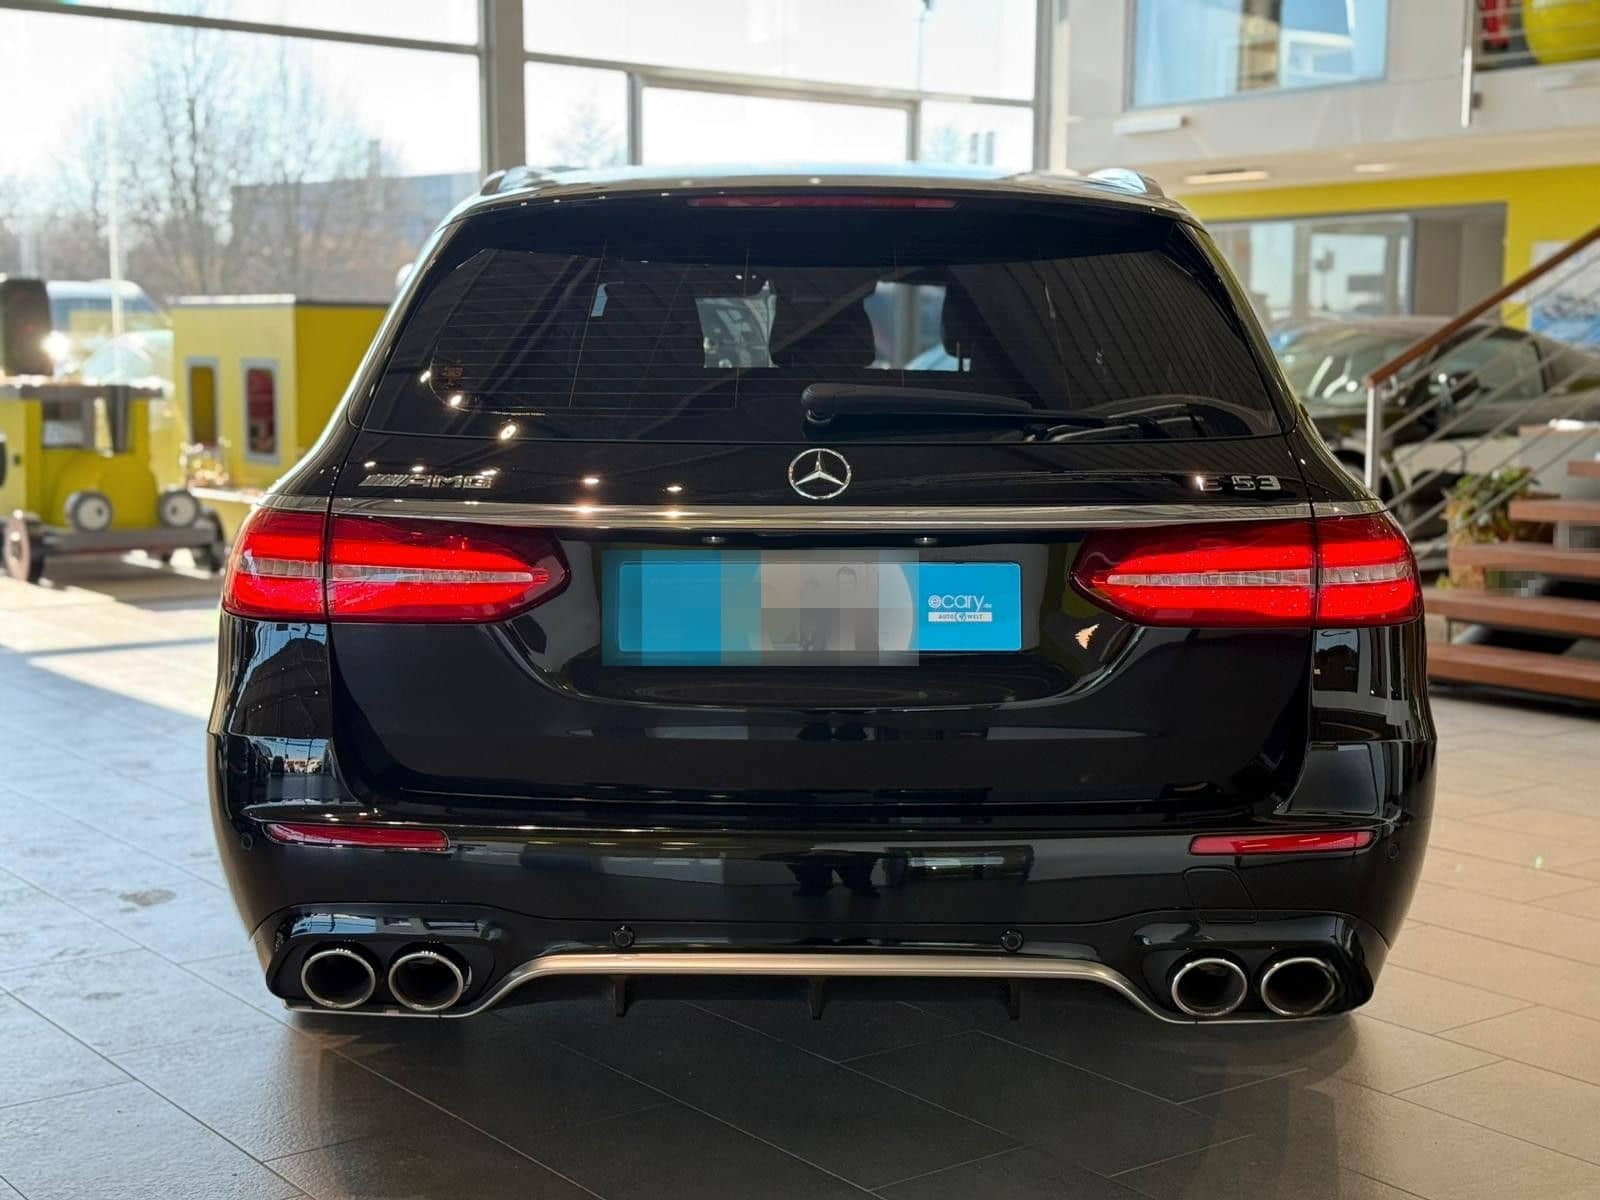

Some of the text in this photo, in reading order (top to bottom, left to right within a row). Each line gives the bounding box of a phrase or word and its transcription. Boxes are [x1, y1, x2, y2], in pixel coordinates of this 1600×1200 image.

[402, 474, 492, 488] AMG
[1195, 475, 1281, 491] E 53
